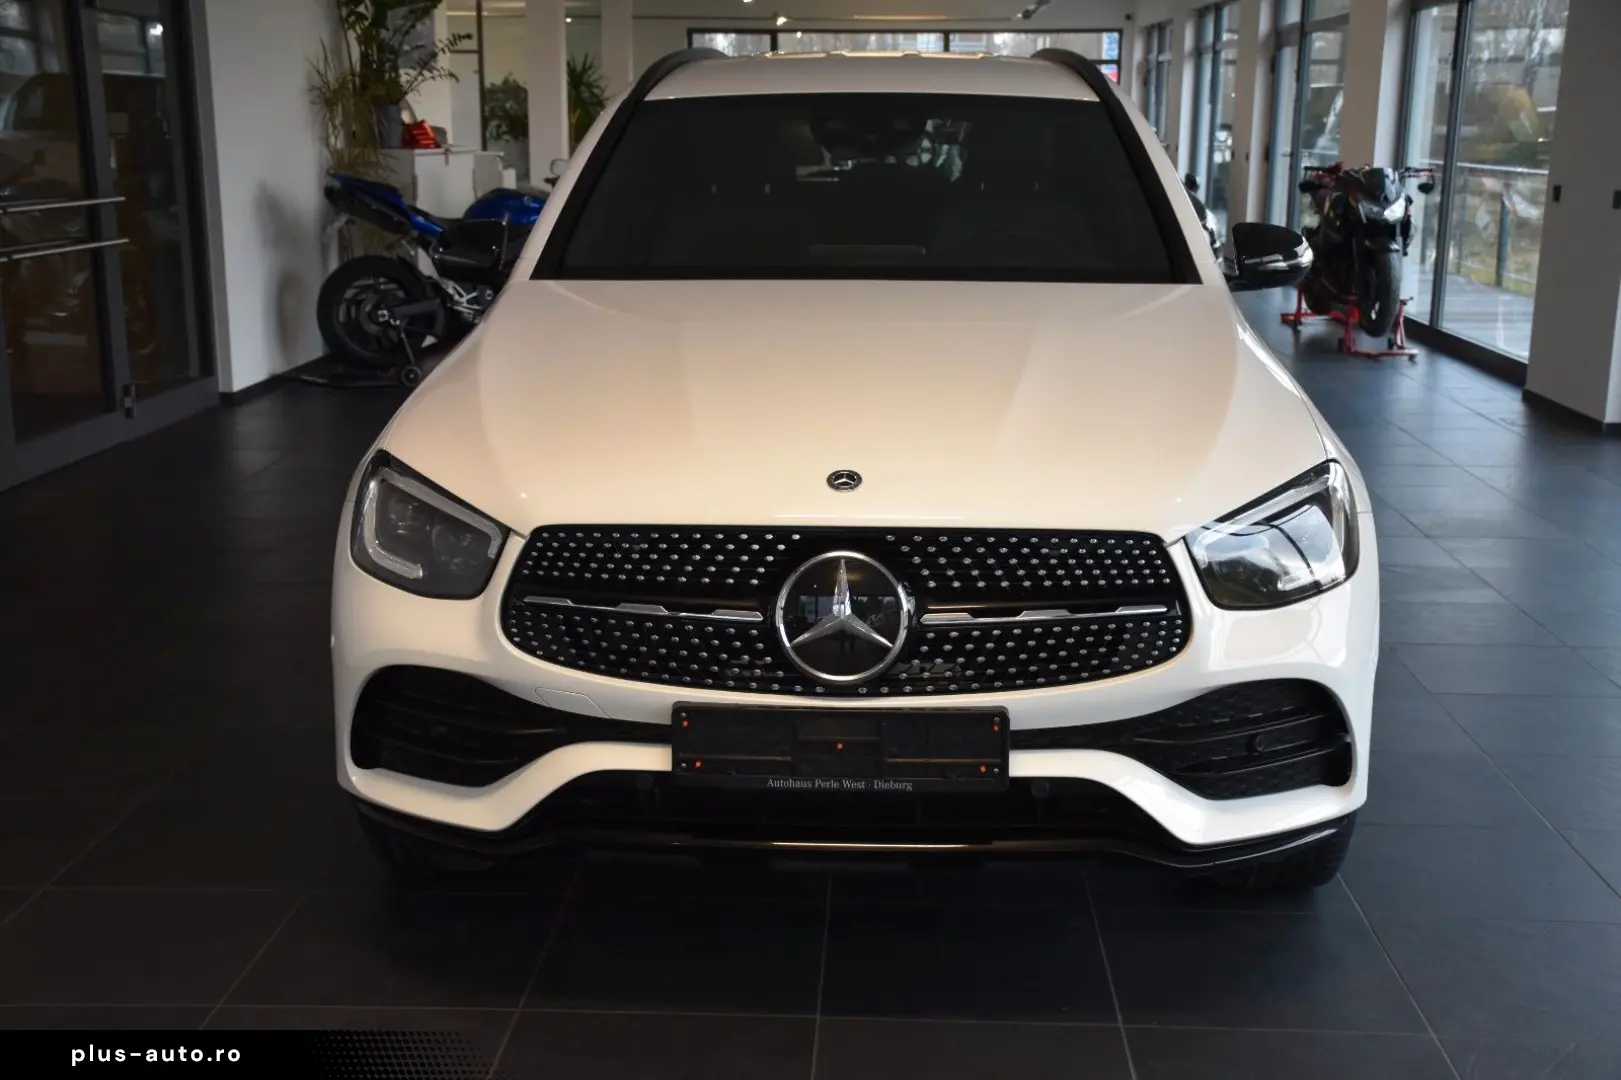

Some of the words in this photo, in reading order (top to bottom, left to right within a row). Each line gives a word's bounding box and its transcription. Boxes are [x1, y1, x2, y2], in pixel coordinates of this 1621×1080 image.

[767, 778, 812, 788] Autohaus
[815, 778, 839, 788] Perle
[842, 779, 865, 789] West
[874, 780, 913, 791] Dieburg
